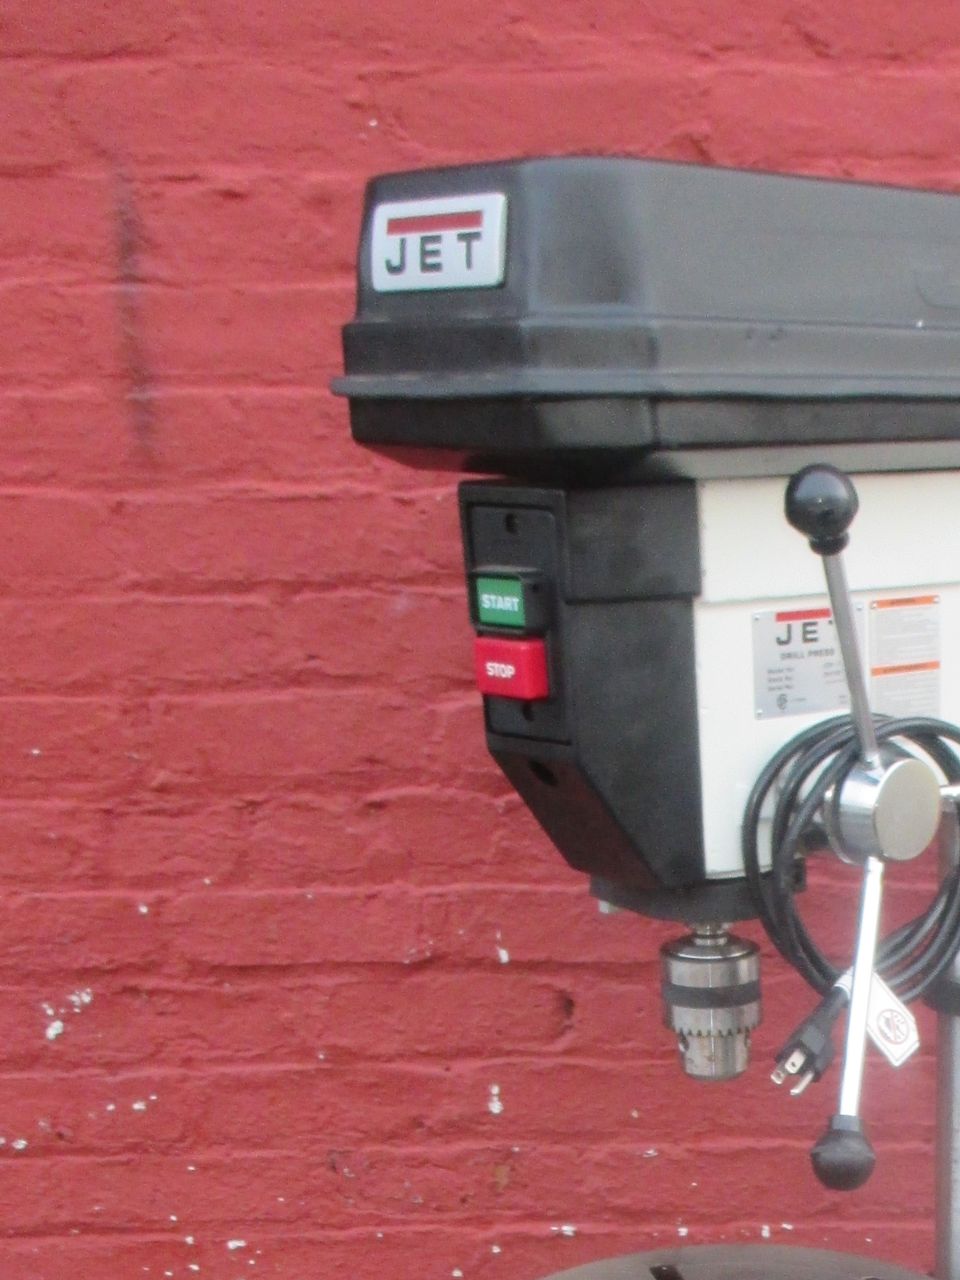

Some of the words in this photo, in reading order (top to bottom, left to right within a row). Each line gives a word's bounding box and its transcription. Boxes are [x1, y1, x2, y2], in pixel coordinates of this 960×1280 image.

[385, 232, 482, 275] JET
[480, 593, 520, 612] START
[776, 621, 834, 646] JE
[485, 661, 516, 679] STOP
